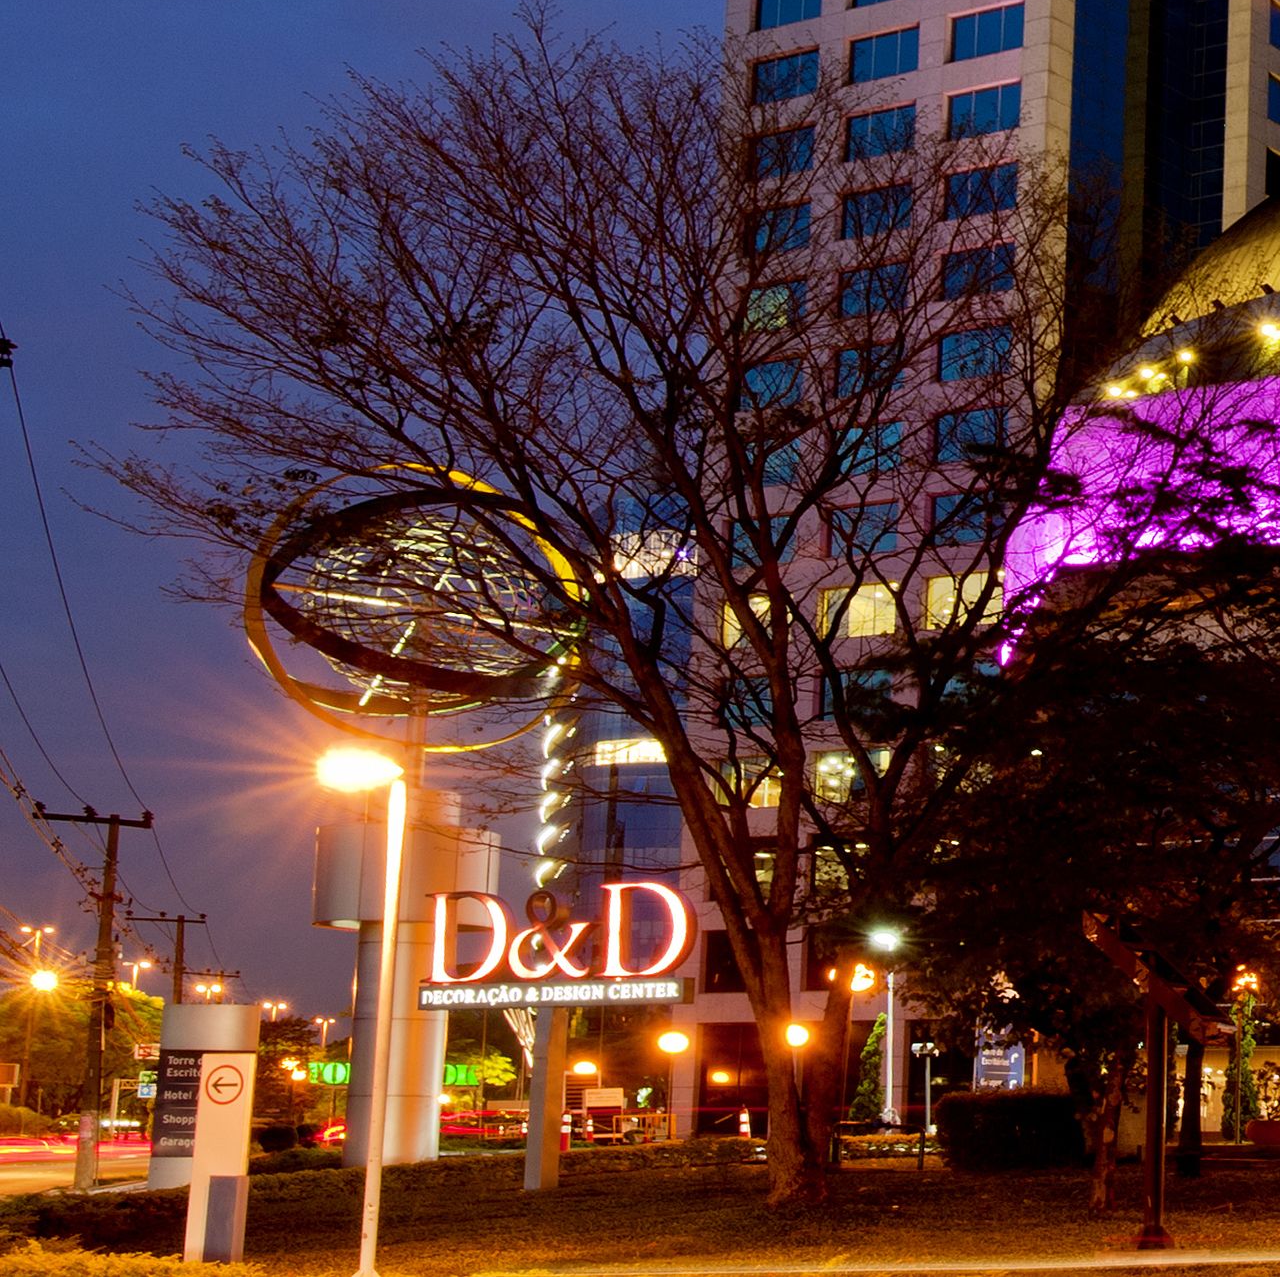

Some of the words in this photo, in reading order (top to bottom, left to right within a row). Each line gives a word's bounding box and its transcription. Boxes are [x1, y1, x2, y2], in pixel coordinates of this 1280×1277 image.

[421, 882, 694, 984] D&D
[421, 985, 523, 1006] DECORAÇÃO
[525, 986, 540, 1002] &
[540, 984, 605, 1002] DESIGN
[608, 981, 680, 999] CENTER
[168, 1056, 195, 1065] Torre
[164, 1091, 192, 1100] Hotel
